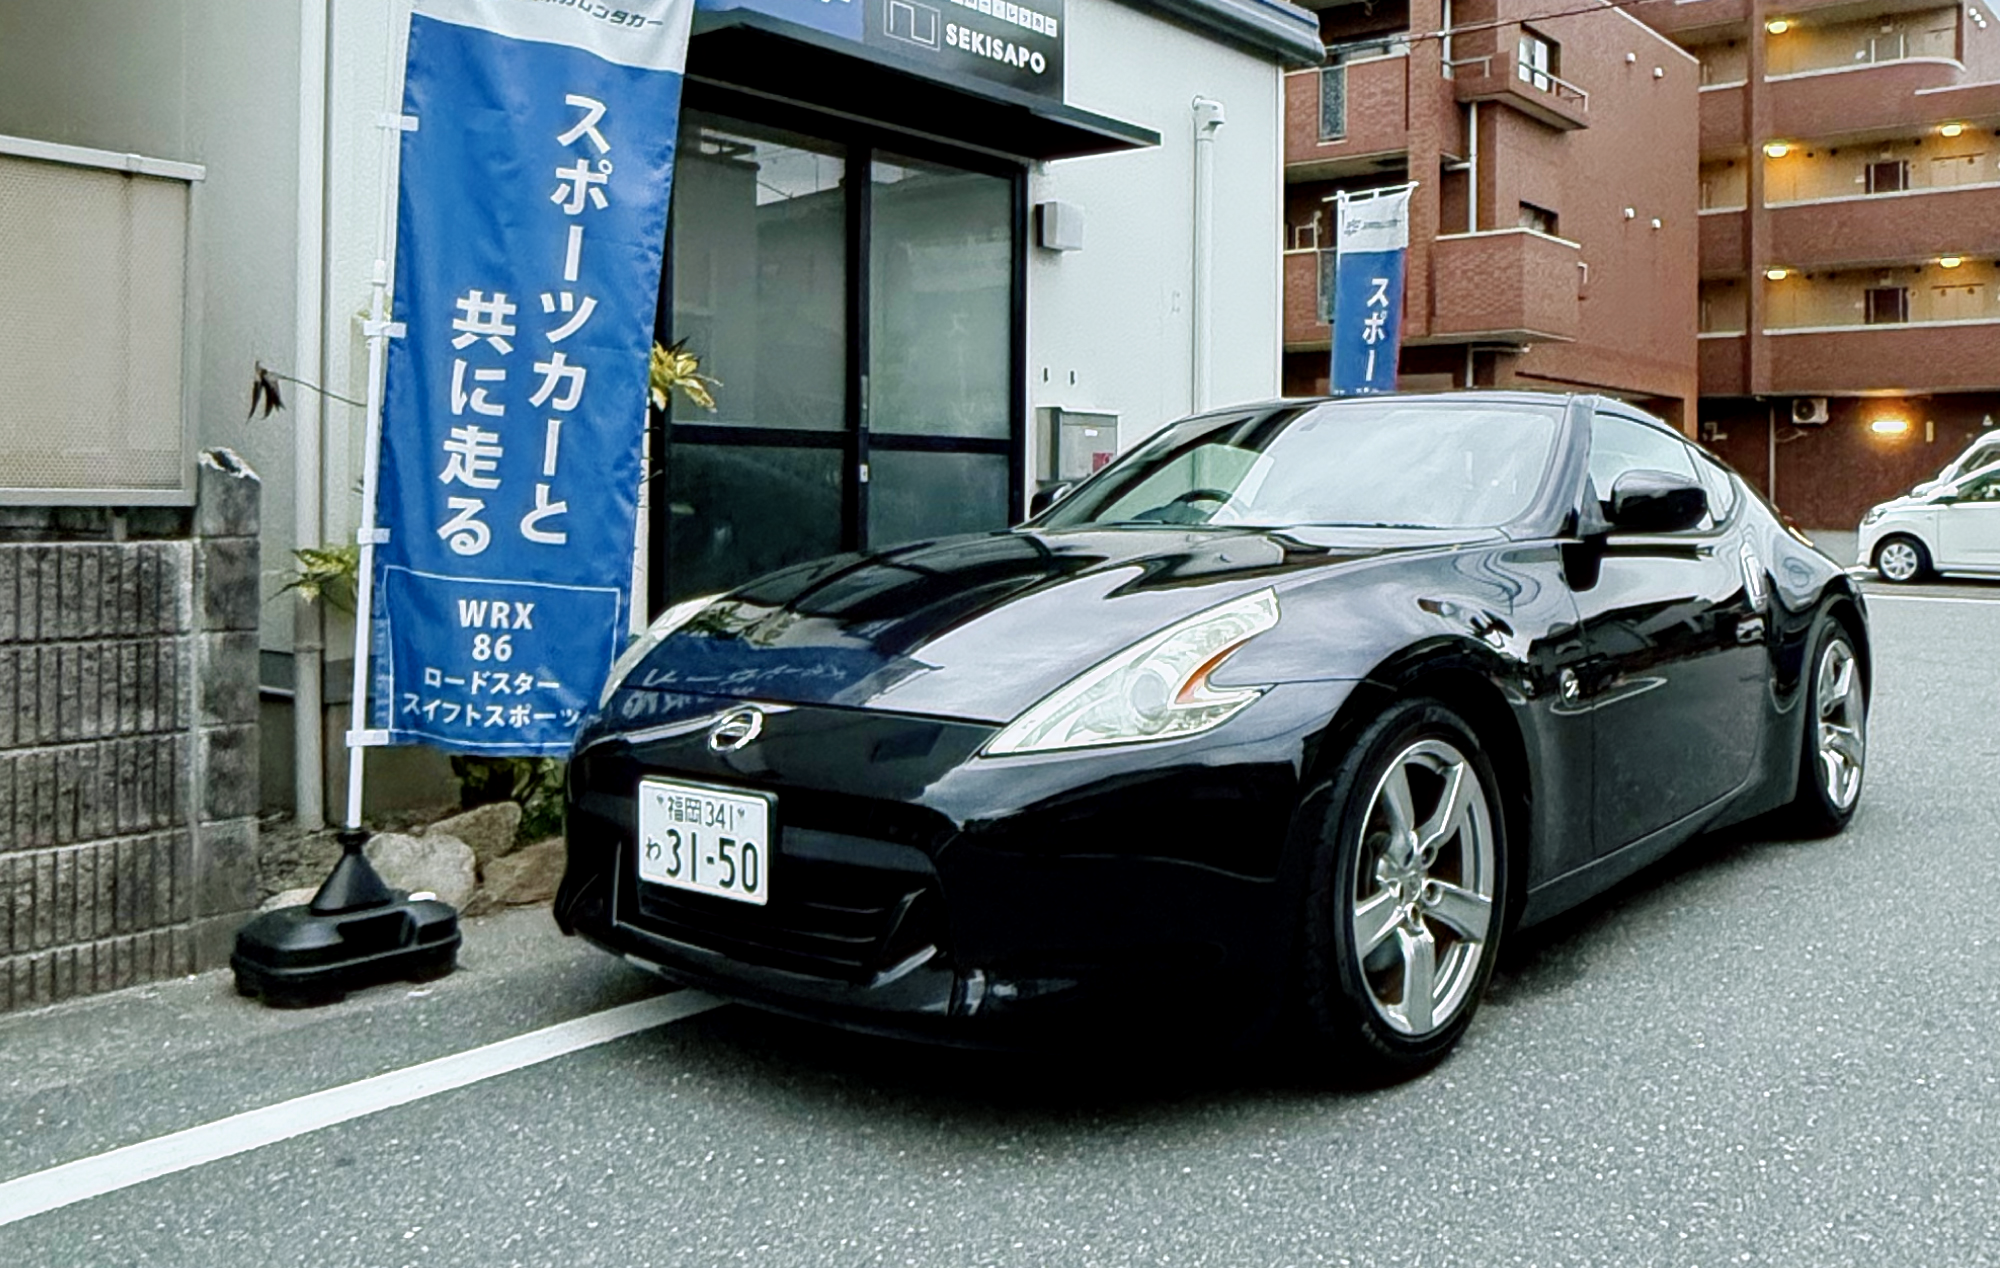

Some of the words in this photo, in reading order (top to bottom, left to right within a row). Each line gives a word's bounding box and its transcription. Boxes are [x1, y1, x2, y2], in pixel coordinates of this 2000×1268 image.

[946, 23, 1046, 74] SEKISAPO
[519, 94, 613, 545] スポーツカーと
[436, 290, 517, 556] 共に走る
[457, 599, 535, 630] WRX
[471, 633, 513, 662] 86
[423, 666, 560, 695] ロードスター
[402, 692, 580, 728] スイフトスポーツ
[645, 837, 662, 861] わ
[666, 828, 758, 893] 31-50
